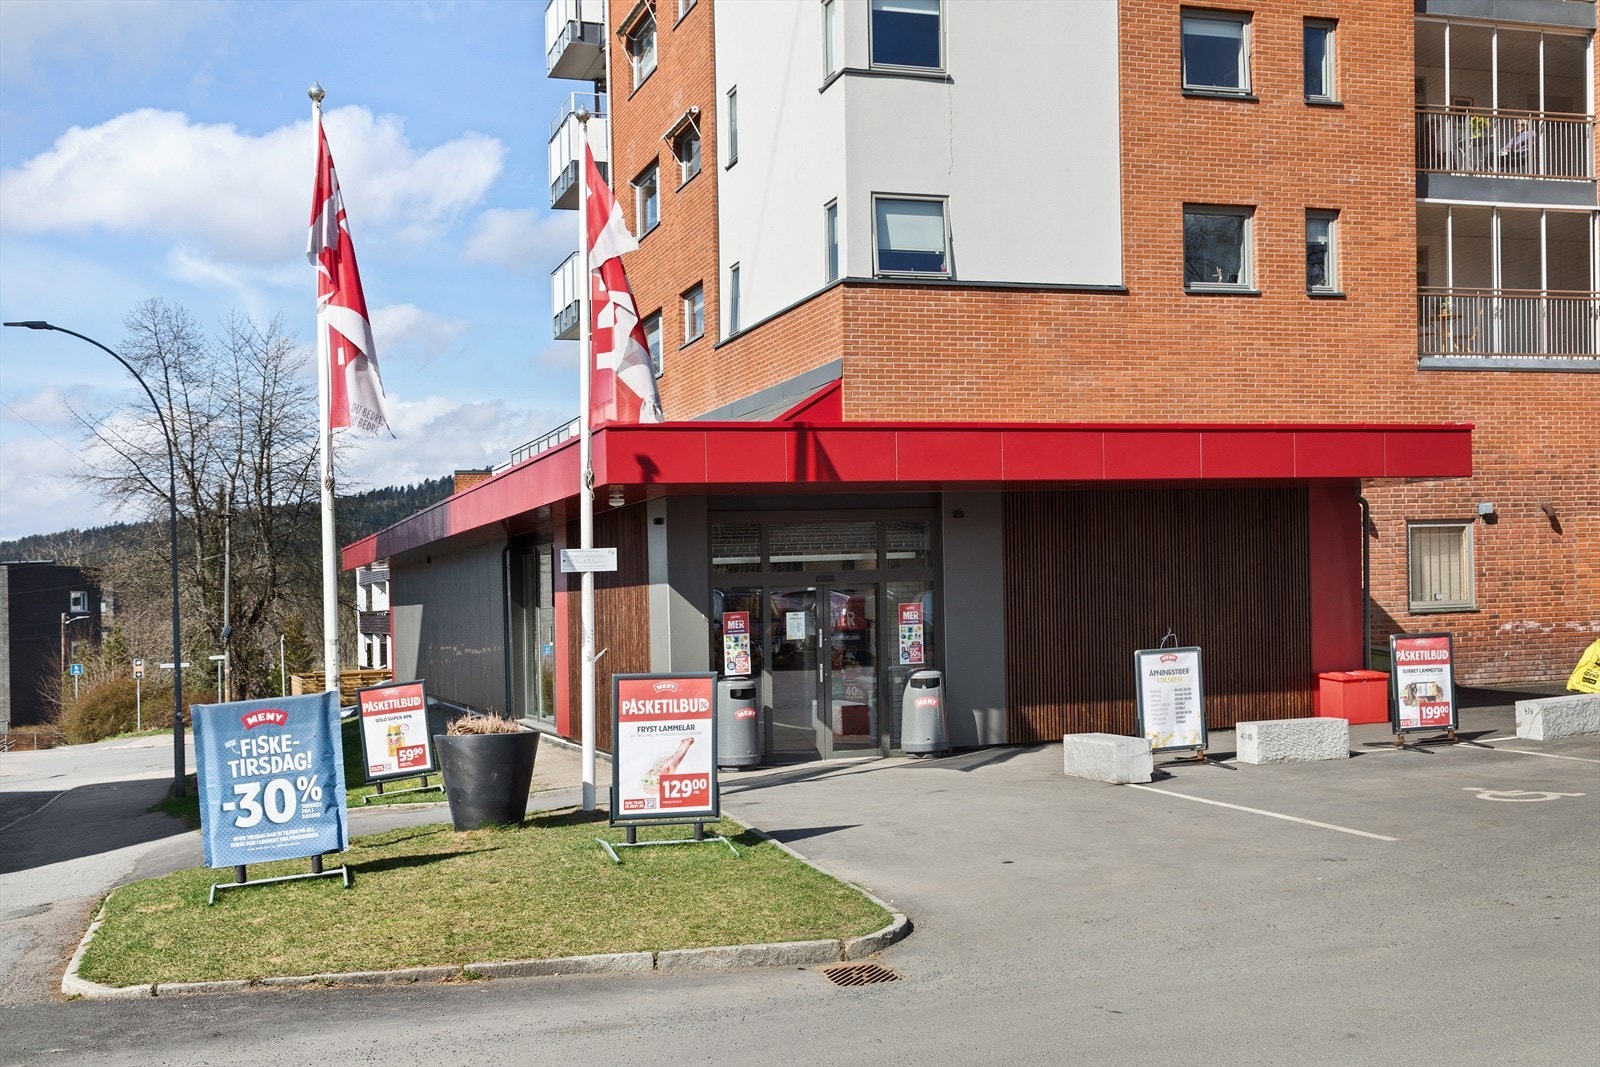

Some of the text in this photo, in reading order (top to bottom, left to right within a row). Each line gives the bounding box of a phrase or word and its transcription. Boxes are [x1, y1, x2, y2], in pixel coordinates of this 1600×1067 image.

[351, 403, 362, 414] DU
[903, 611, 919, 621] MER
[727, 620, 745, 630] MER
[1149, 668, 1190, 677] ÅPNINGSTIDER
[246, 712, 284, 725] MENY
[737, 710, 755, 718] MENY
[637, 723, 696, 733] FRYST LAMMELÅR
[240, 734, 300, 757] FISKE-
[227, 751, 312, 778] TIRSDAG!
[223, 775, 322, 828] -30%
